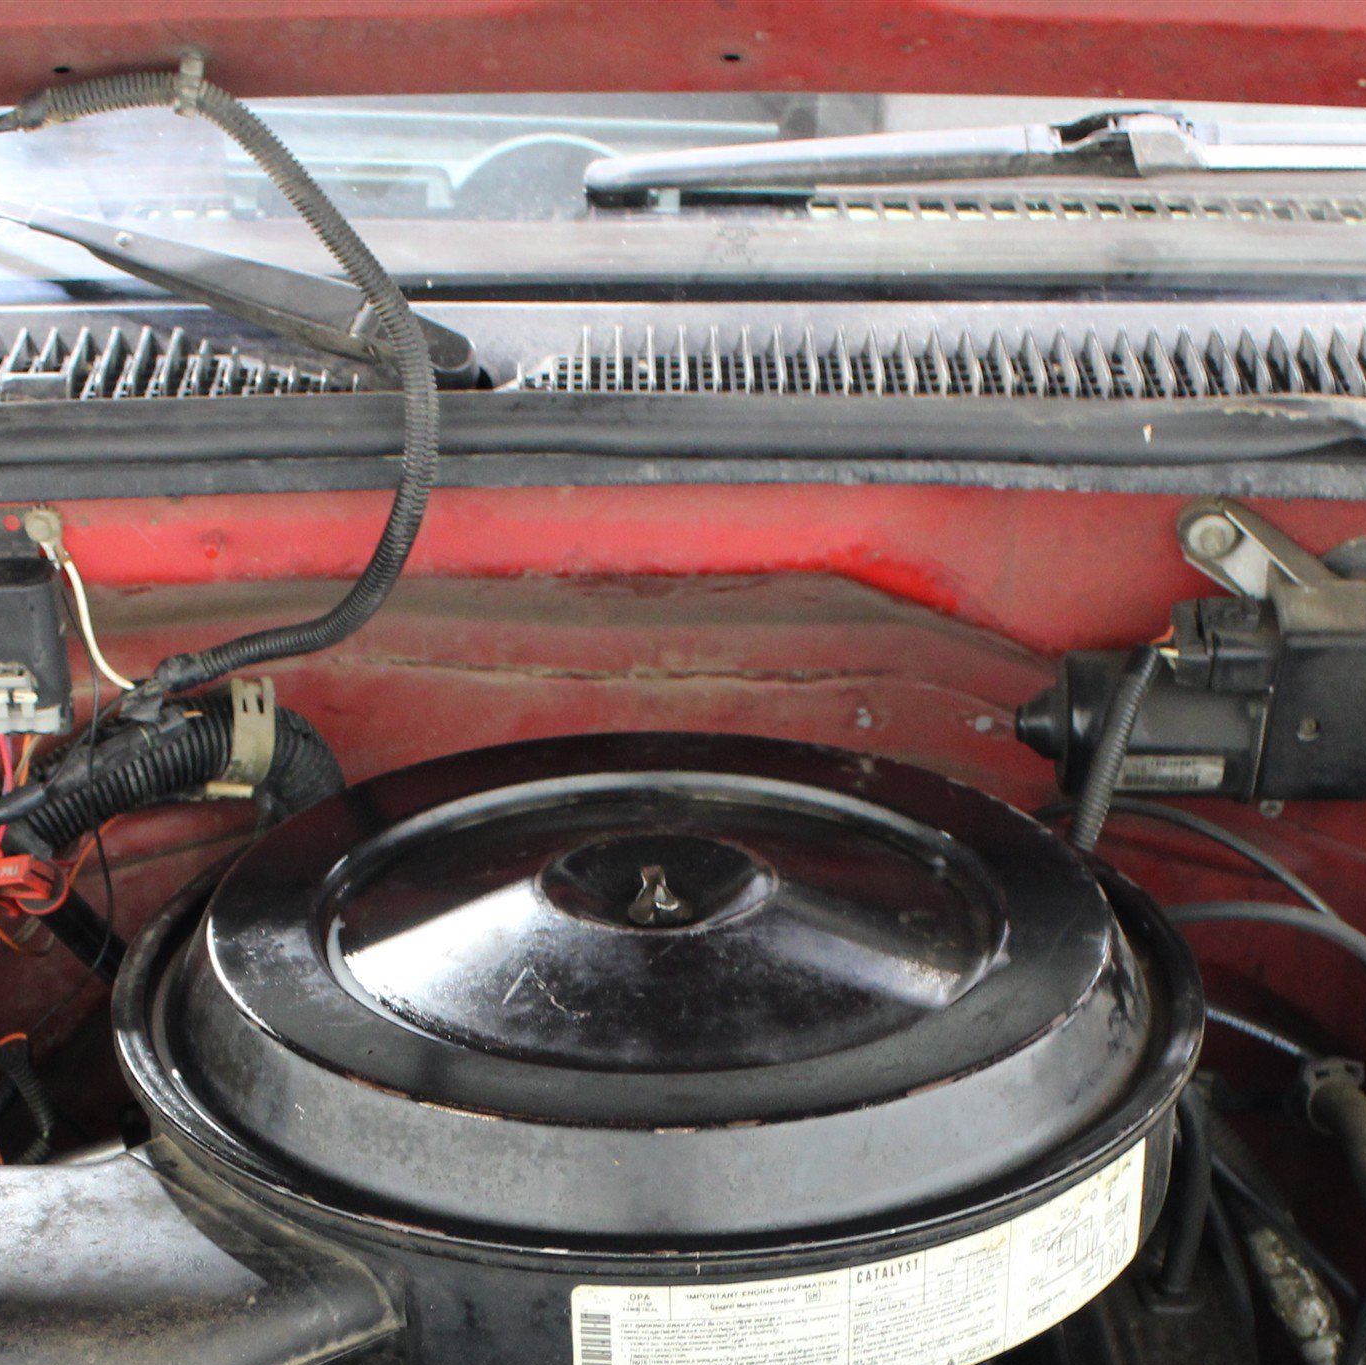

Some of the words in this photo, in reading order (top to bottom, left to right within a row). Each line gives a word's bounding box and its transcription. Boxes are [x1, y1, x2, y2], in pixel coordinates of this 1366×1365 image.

[856, 1258, 920, 1284] CATALYST
[686, 1291, 738, 1301] IMPORTANT
[741, 1287, 775, 1298] ENGINE
[777, 1278, 838, 1294] INFORMATION
